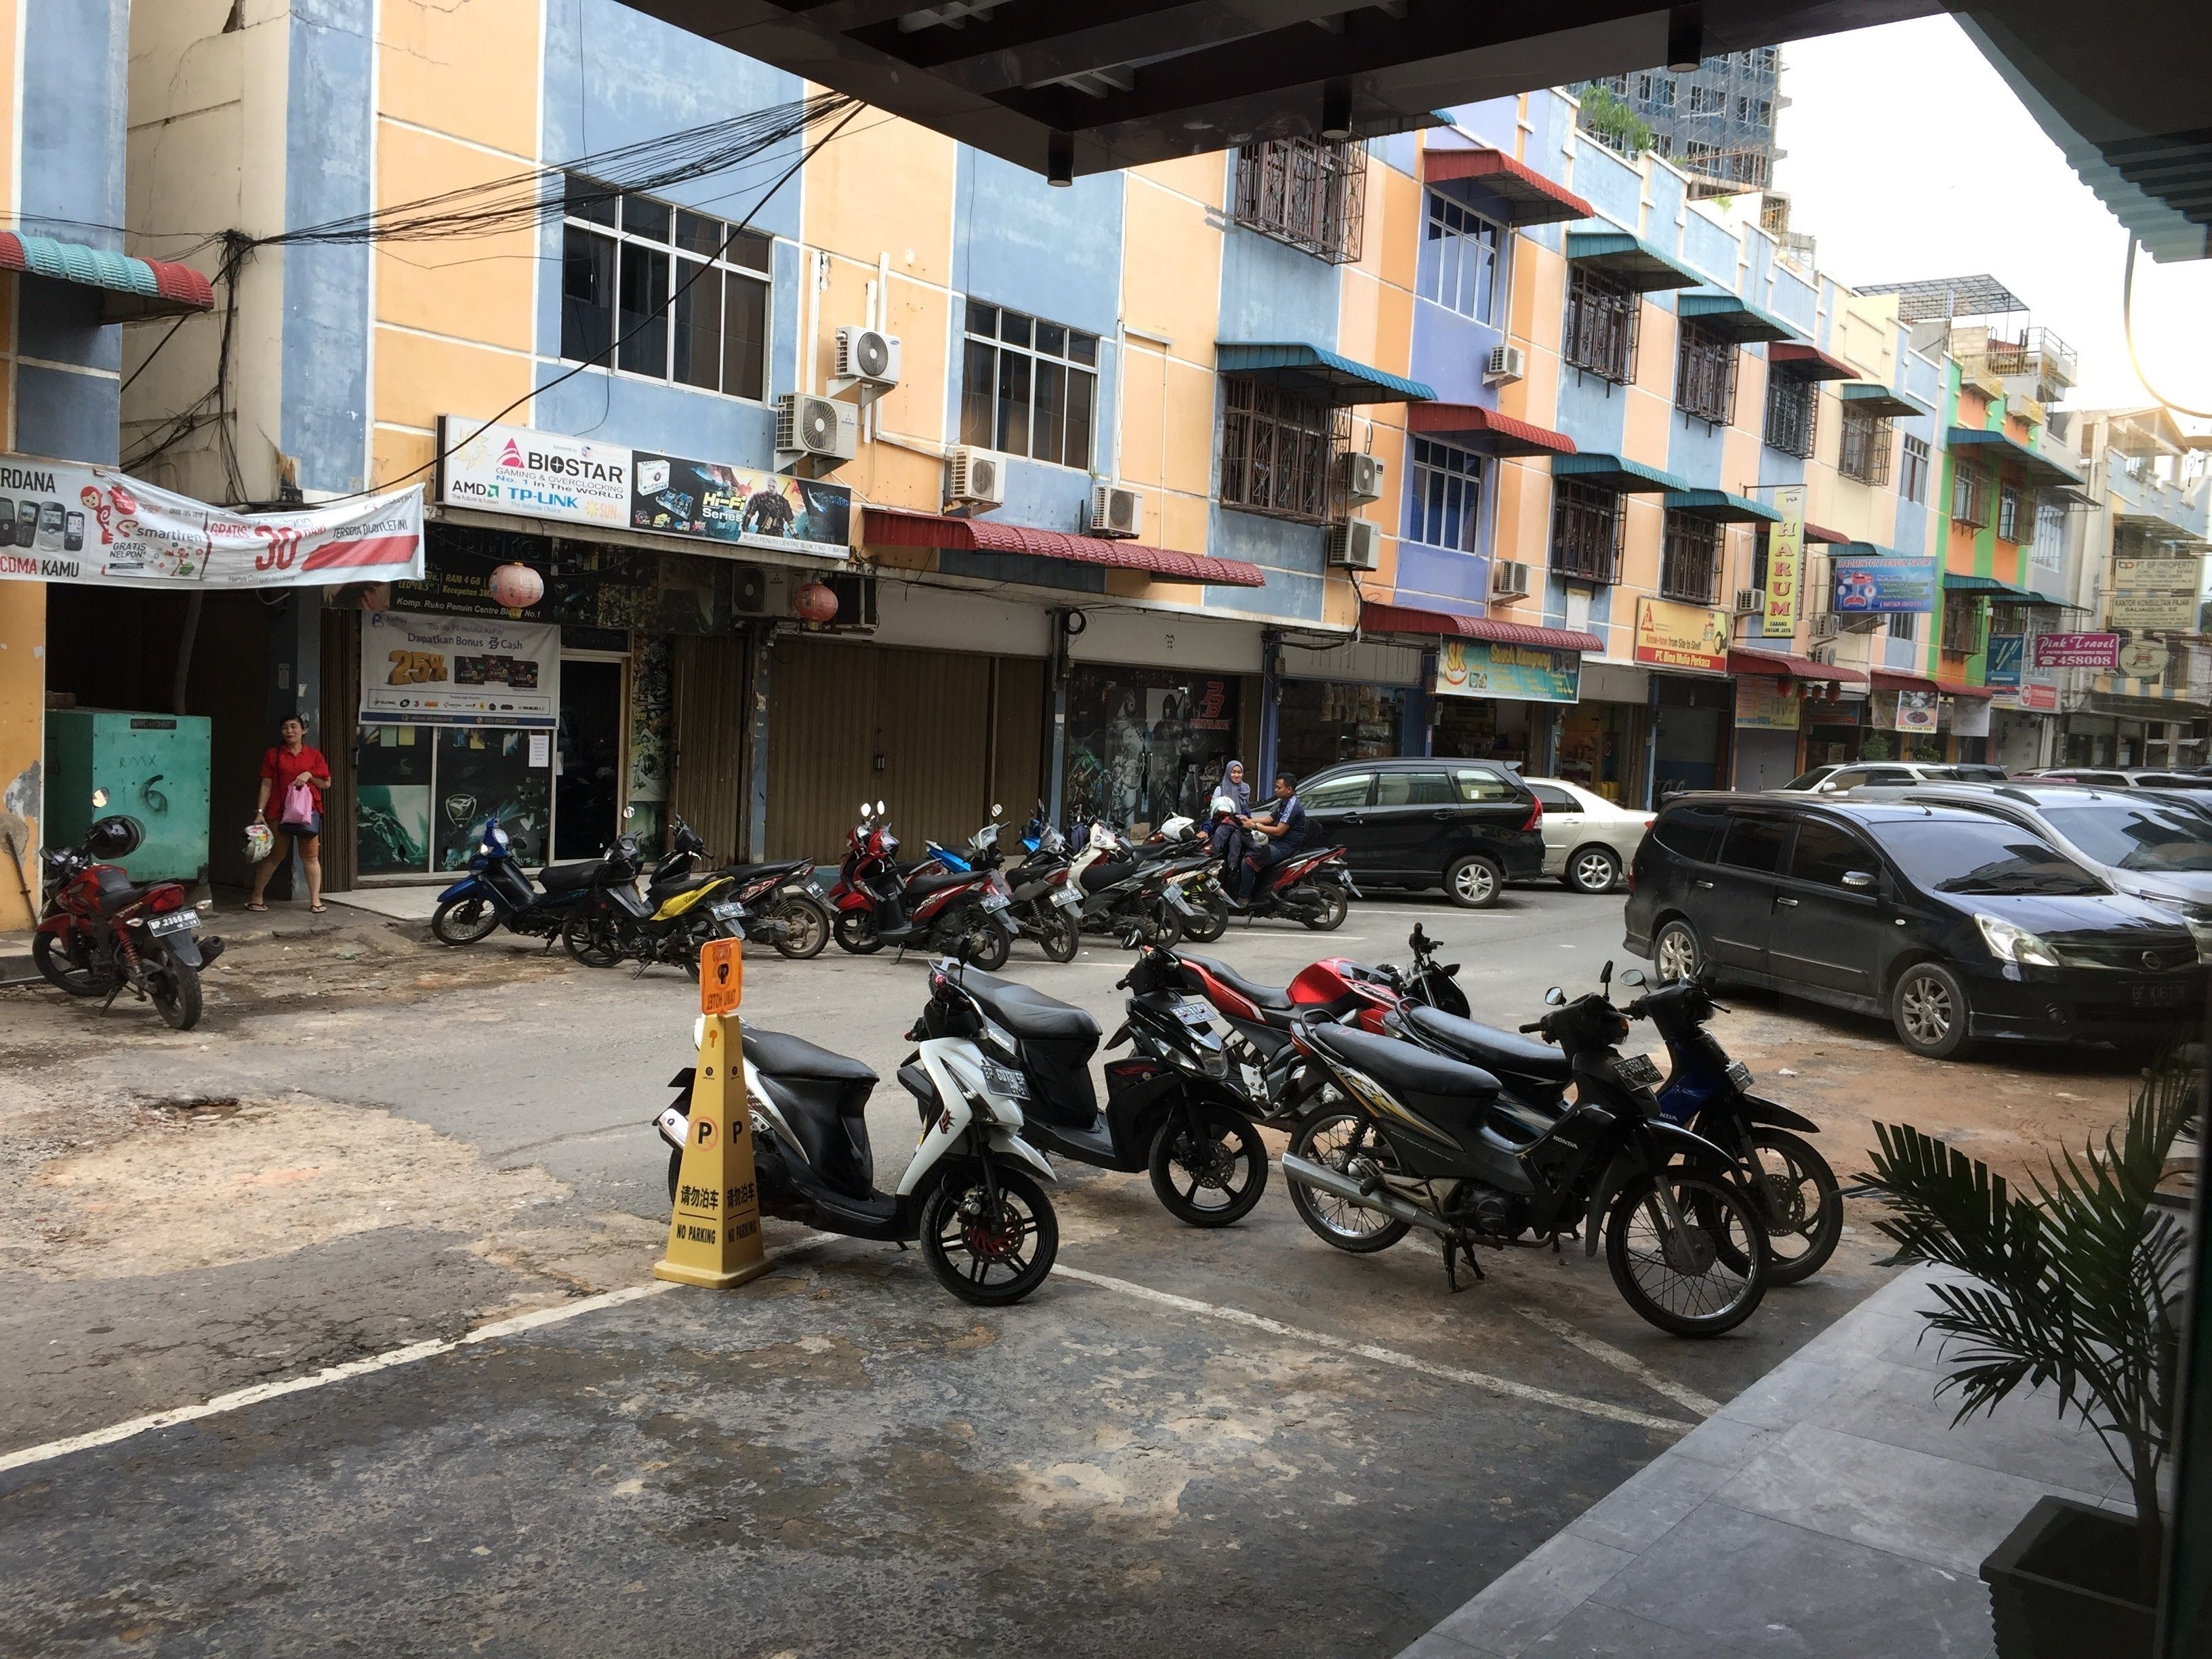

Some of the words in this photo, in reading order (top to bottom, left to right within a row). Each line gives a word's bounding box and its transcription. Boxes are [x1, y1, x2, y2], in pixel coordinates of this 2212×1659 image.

[528, 451, 623, 484] BIOSTAR
[0, 468, 56, 493] RDANA
[452, 480, 486, 496] AMD
[495, 467, 537, 480] GAMING
[548, 476, 623, 493] OVERCLOCKING
[508, 487, 579, 509] TP-LINK
[550, 483, 572, 492] The
[576, 487, 623, 499] WORLD
[483, 497, 499, 506] fusion
[702, 491, 747, 512] Hi-Fi
[599, 503, 617, 520] SUN
[702, 508, 743, 523] Series
[743, 534, 758, 542] RUKO
[112, 542, 146, 552] GRATIS
[255, 525, 302, 571] 30
[0, 555, 37, 575] CDMA
[41, 560, 79, 577] KAMU
[1769, 523, 1796, 617] HARUM
[1838, 558, 1881, 568] BADMINTON
[1909, 558, 1932, 567] SPORT
[2158, 560, 2195, 569] PROPERTY
[445, 574, 462, 583] RAM
[470, 577, 481, 586] GB
[396, 597, 422, 609] Komp.
[424, 600, 444, 610] Ruko
[447, 602, 472, 612] Penuin
[474, 605, 499, 615] Centre
[2114, 598, 2136, 607] KANTOR
[2137, 599, 2171, 607] KONSULTAN
[2172, 598, 2190, 607] PAJAK
[407, 632, 454, 646] Dapatkan
[456, 636, 483, 647] Bonus
[501, 640, 523, 650] Cash
[1668, 636, 1678, 648] from
[2039, 636, 2066, 651] Pink
[2070, 636, 2114, 649] Travel
[387, 649, 449, 686] 25%
[2057, 655, 2112, 665] 458008
[150, 921, 161, 930] BP
[1659, 1111, 1679, 1122] NDA
[697, 1122, 712, 1145] P
[733, 1120, 743, 1144] P
[1552, 1134, 1579, 1150] HONDA
[680, 1184, 719, 1211] 请勿泊车
[726, 1181, 756, 1210] 请勿泊车
[677, 1223, 686, 1240] NO
[689, 1224, 716, 1245] PARKING
[728, 1229, 735, 1244] NO
[736, 1220, 757, 1242] PARKING
